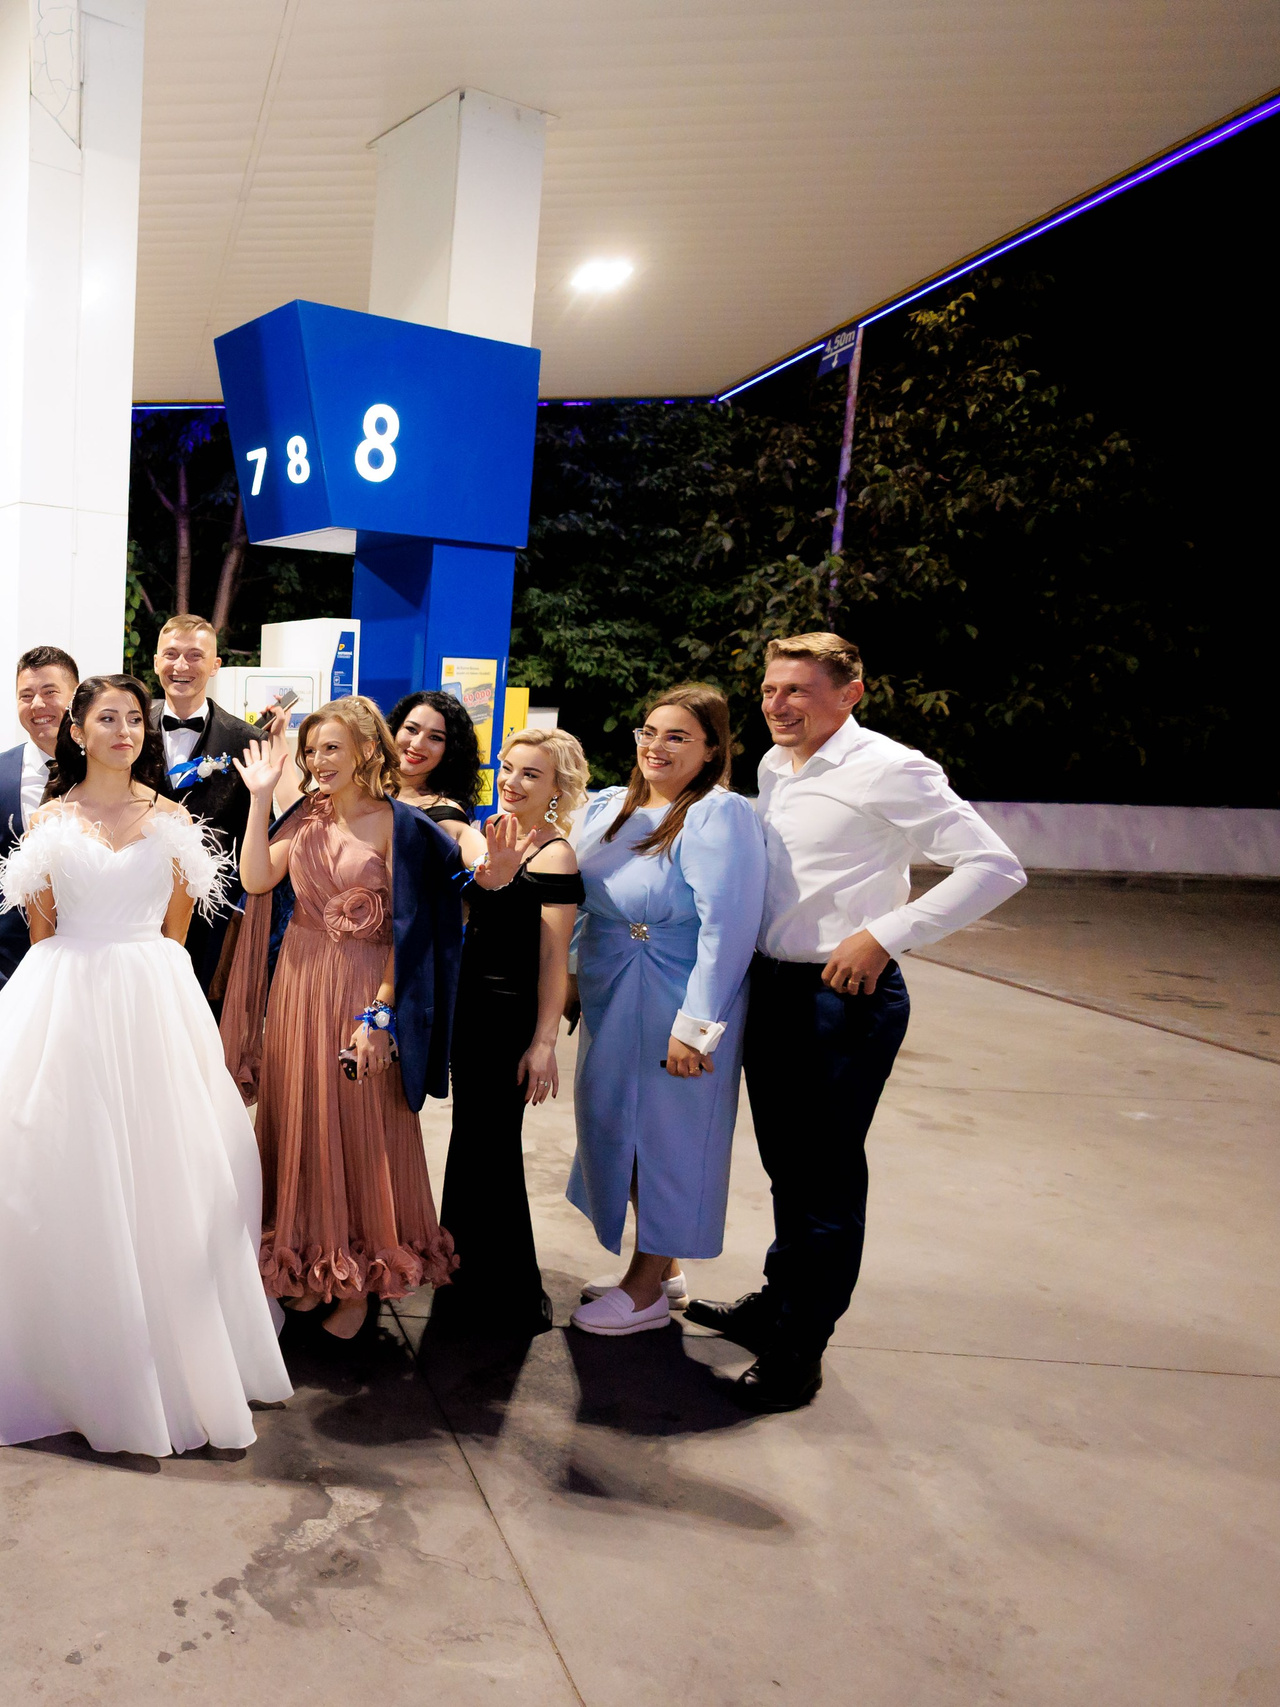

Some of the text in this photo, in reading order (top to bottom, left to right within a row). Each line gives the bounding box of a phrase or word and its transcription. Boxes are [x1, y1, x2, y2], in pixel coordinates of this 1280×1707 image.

[246, 435, 311, 496] 7 8
[355, 403, 400, 483] 8
[248, 714, 254, 723] 8
